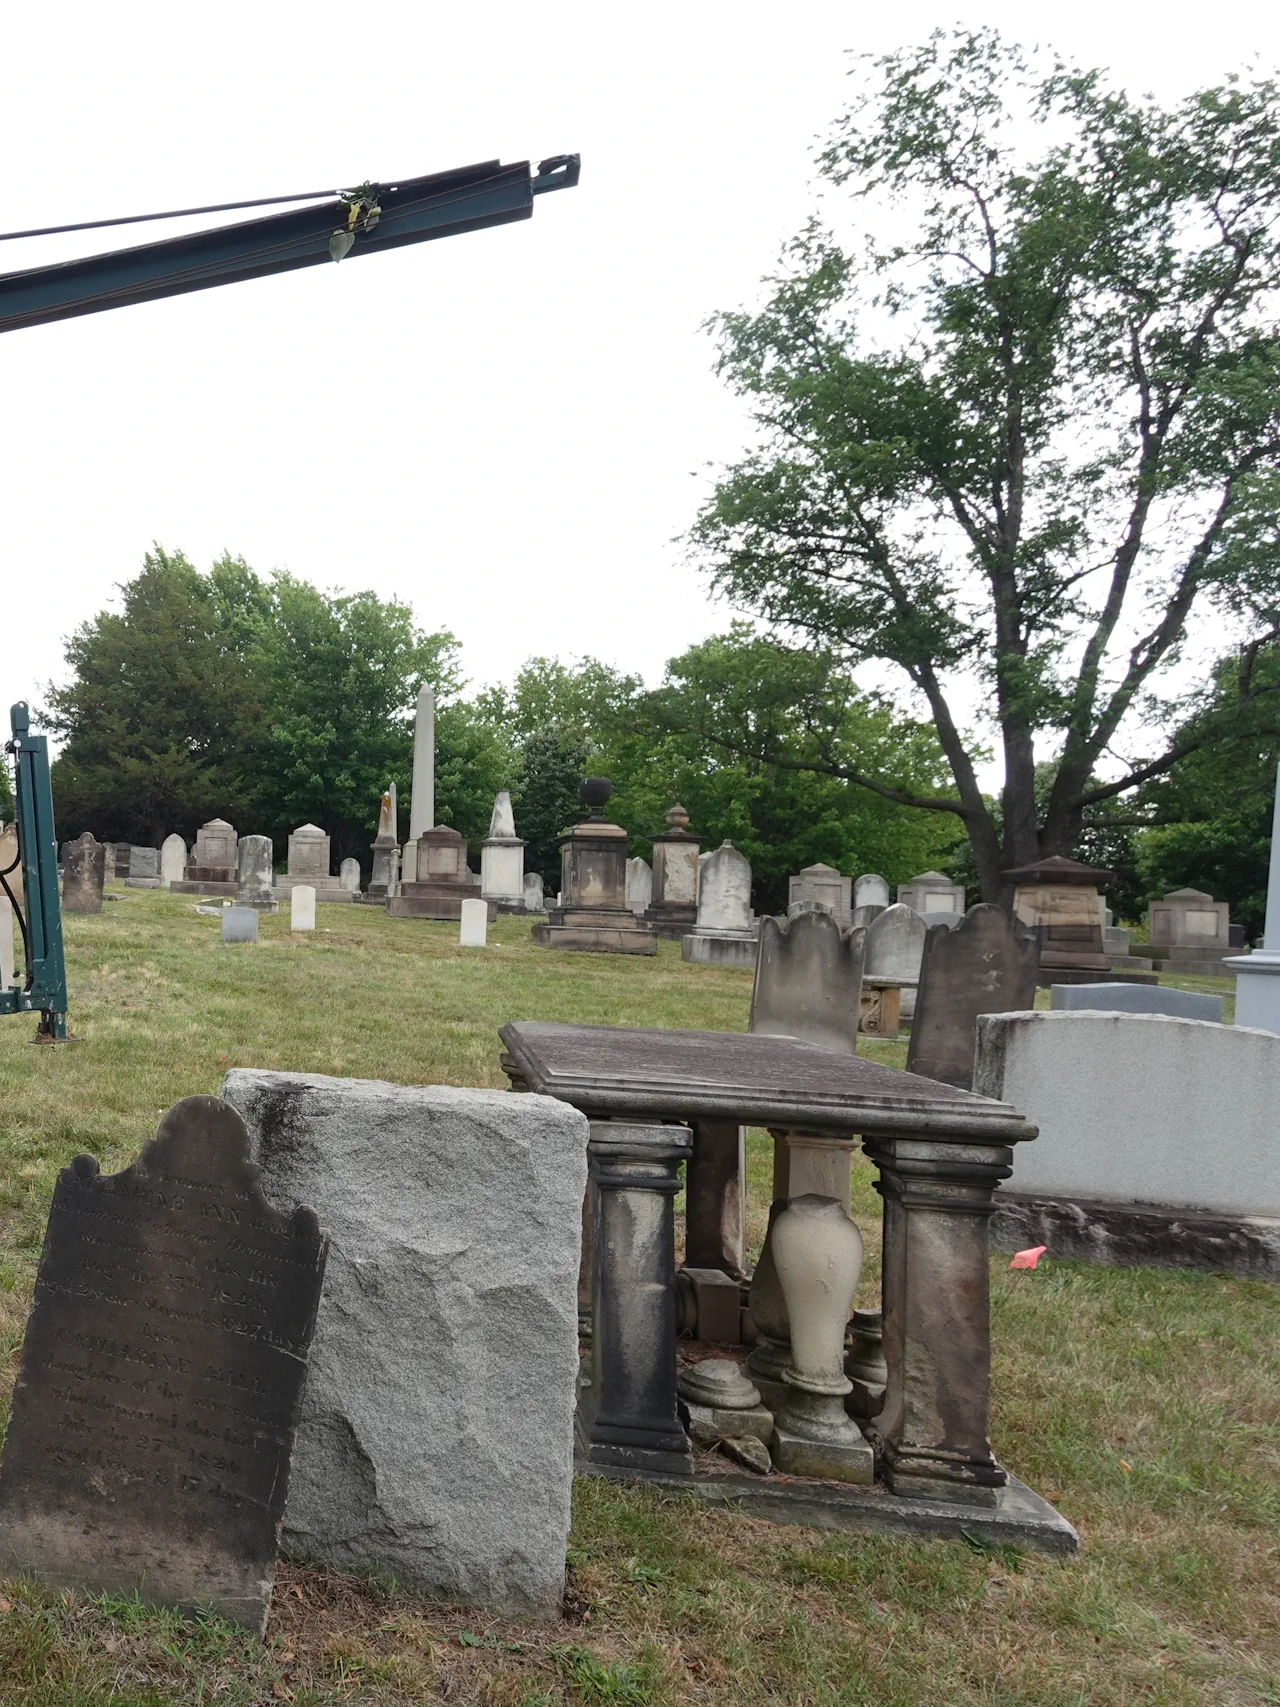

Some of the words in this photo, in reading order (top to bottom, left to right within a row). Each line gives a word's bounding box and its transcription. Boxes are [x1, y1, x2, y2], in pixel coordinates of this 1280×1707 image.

[56, 1168, 185, 1212] CATHARINE
[196, 1200, 244, 1226] ANN
[53, 1327, 191, 1375] CATHARINE
